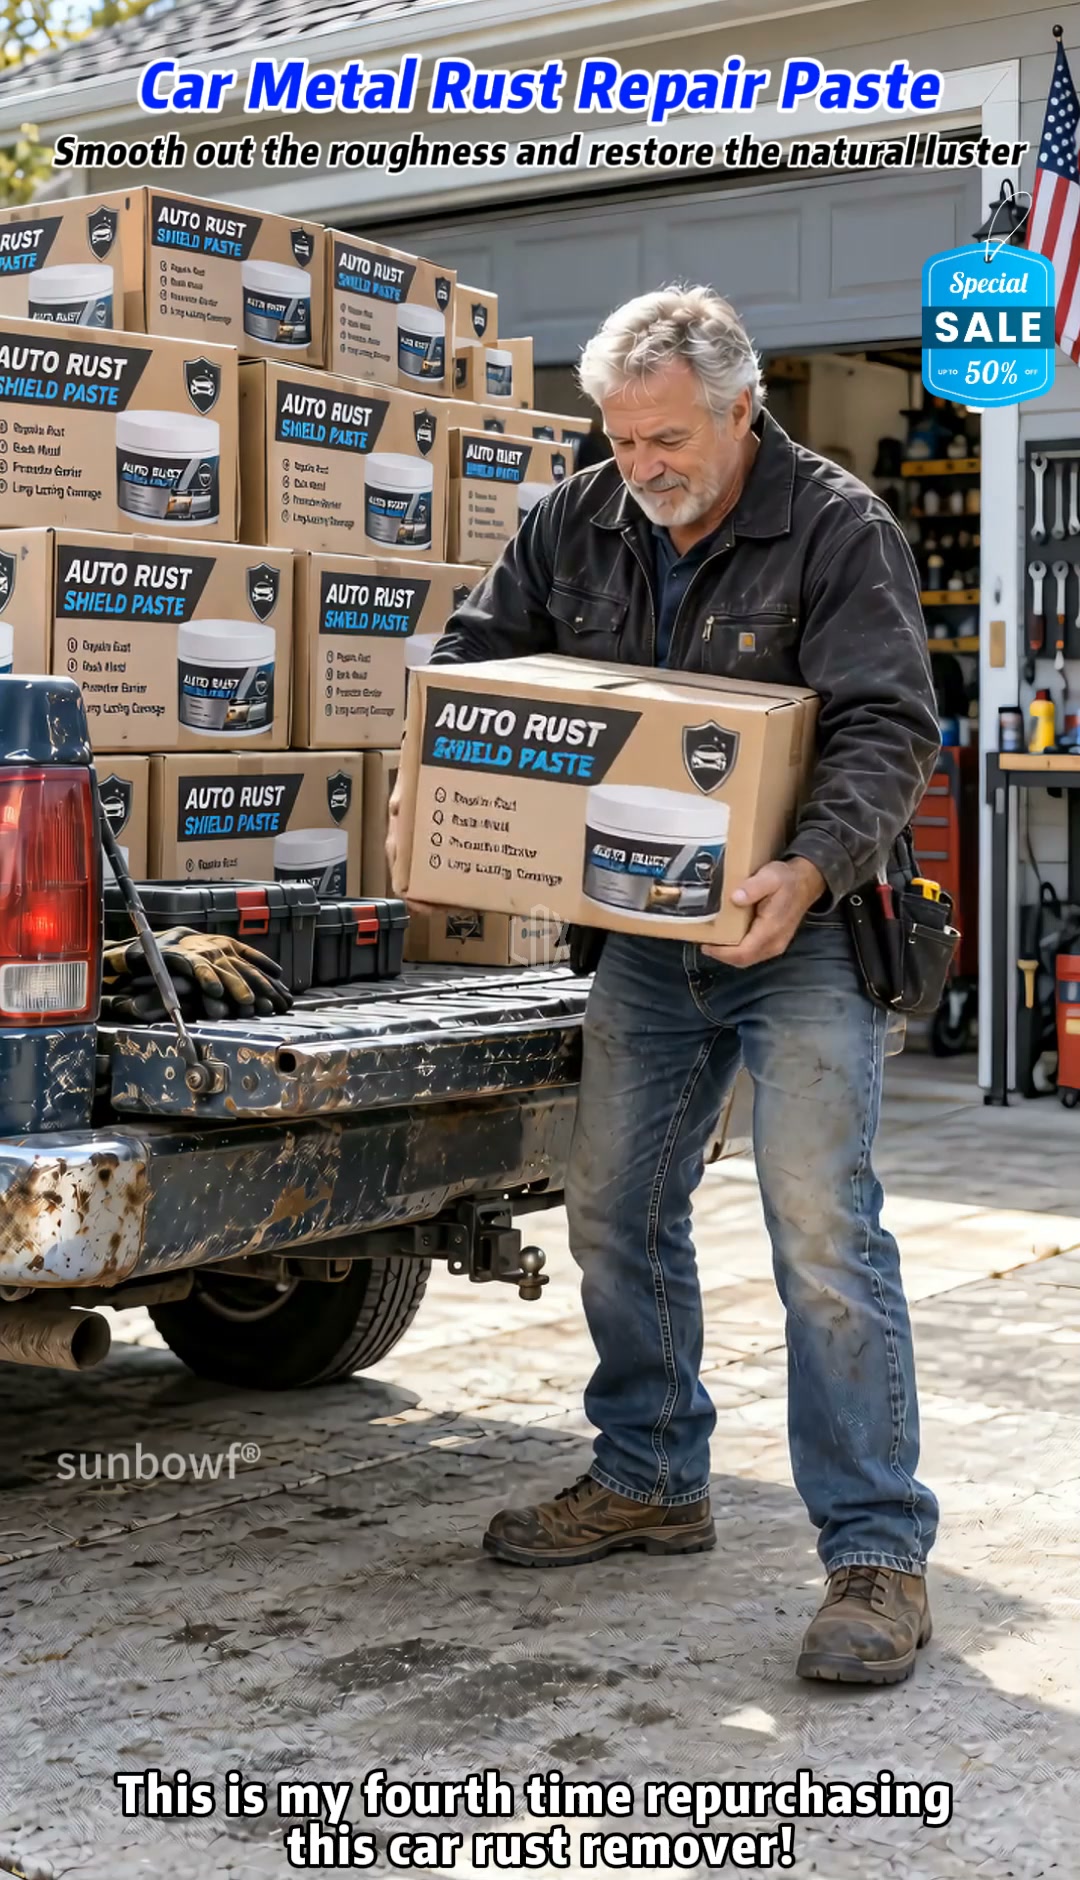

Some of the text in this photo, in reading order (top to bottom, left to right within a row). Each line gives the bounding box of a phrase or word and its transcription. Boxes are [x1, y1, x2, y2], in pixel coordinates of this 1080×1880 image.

[157, 206, 247, 239] AUTO RUST
[0, 228, 44, 252] RUST
[338, 253, 371, 275] AUTO
[0, 345, 128, 380] AUTO RUST
[0, 376, 119, 406] SHIELD PASTE
[281, 393, 373, 427] AUTO RUST
[64, 559, 193, 590] AUTO RUST
[63, 590, 186, 617] SHIELD PASTE
[325, 584, 415, 609] AUTO RUST
[324, 609, 410, 632] SHIELD PASTE
[435, 703, 607, 748] AUTO RUST
[518, 747, 595, 778] PASTE
[185, 785, 286, 810] AUTO RUST
[184, 812, 280, 835] SHIELD PASTE
